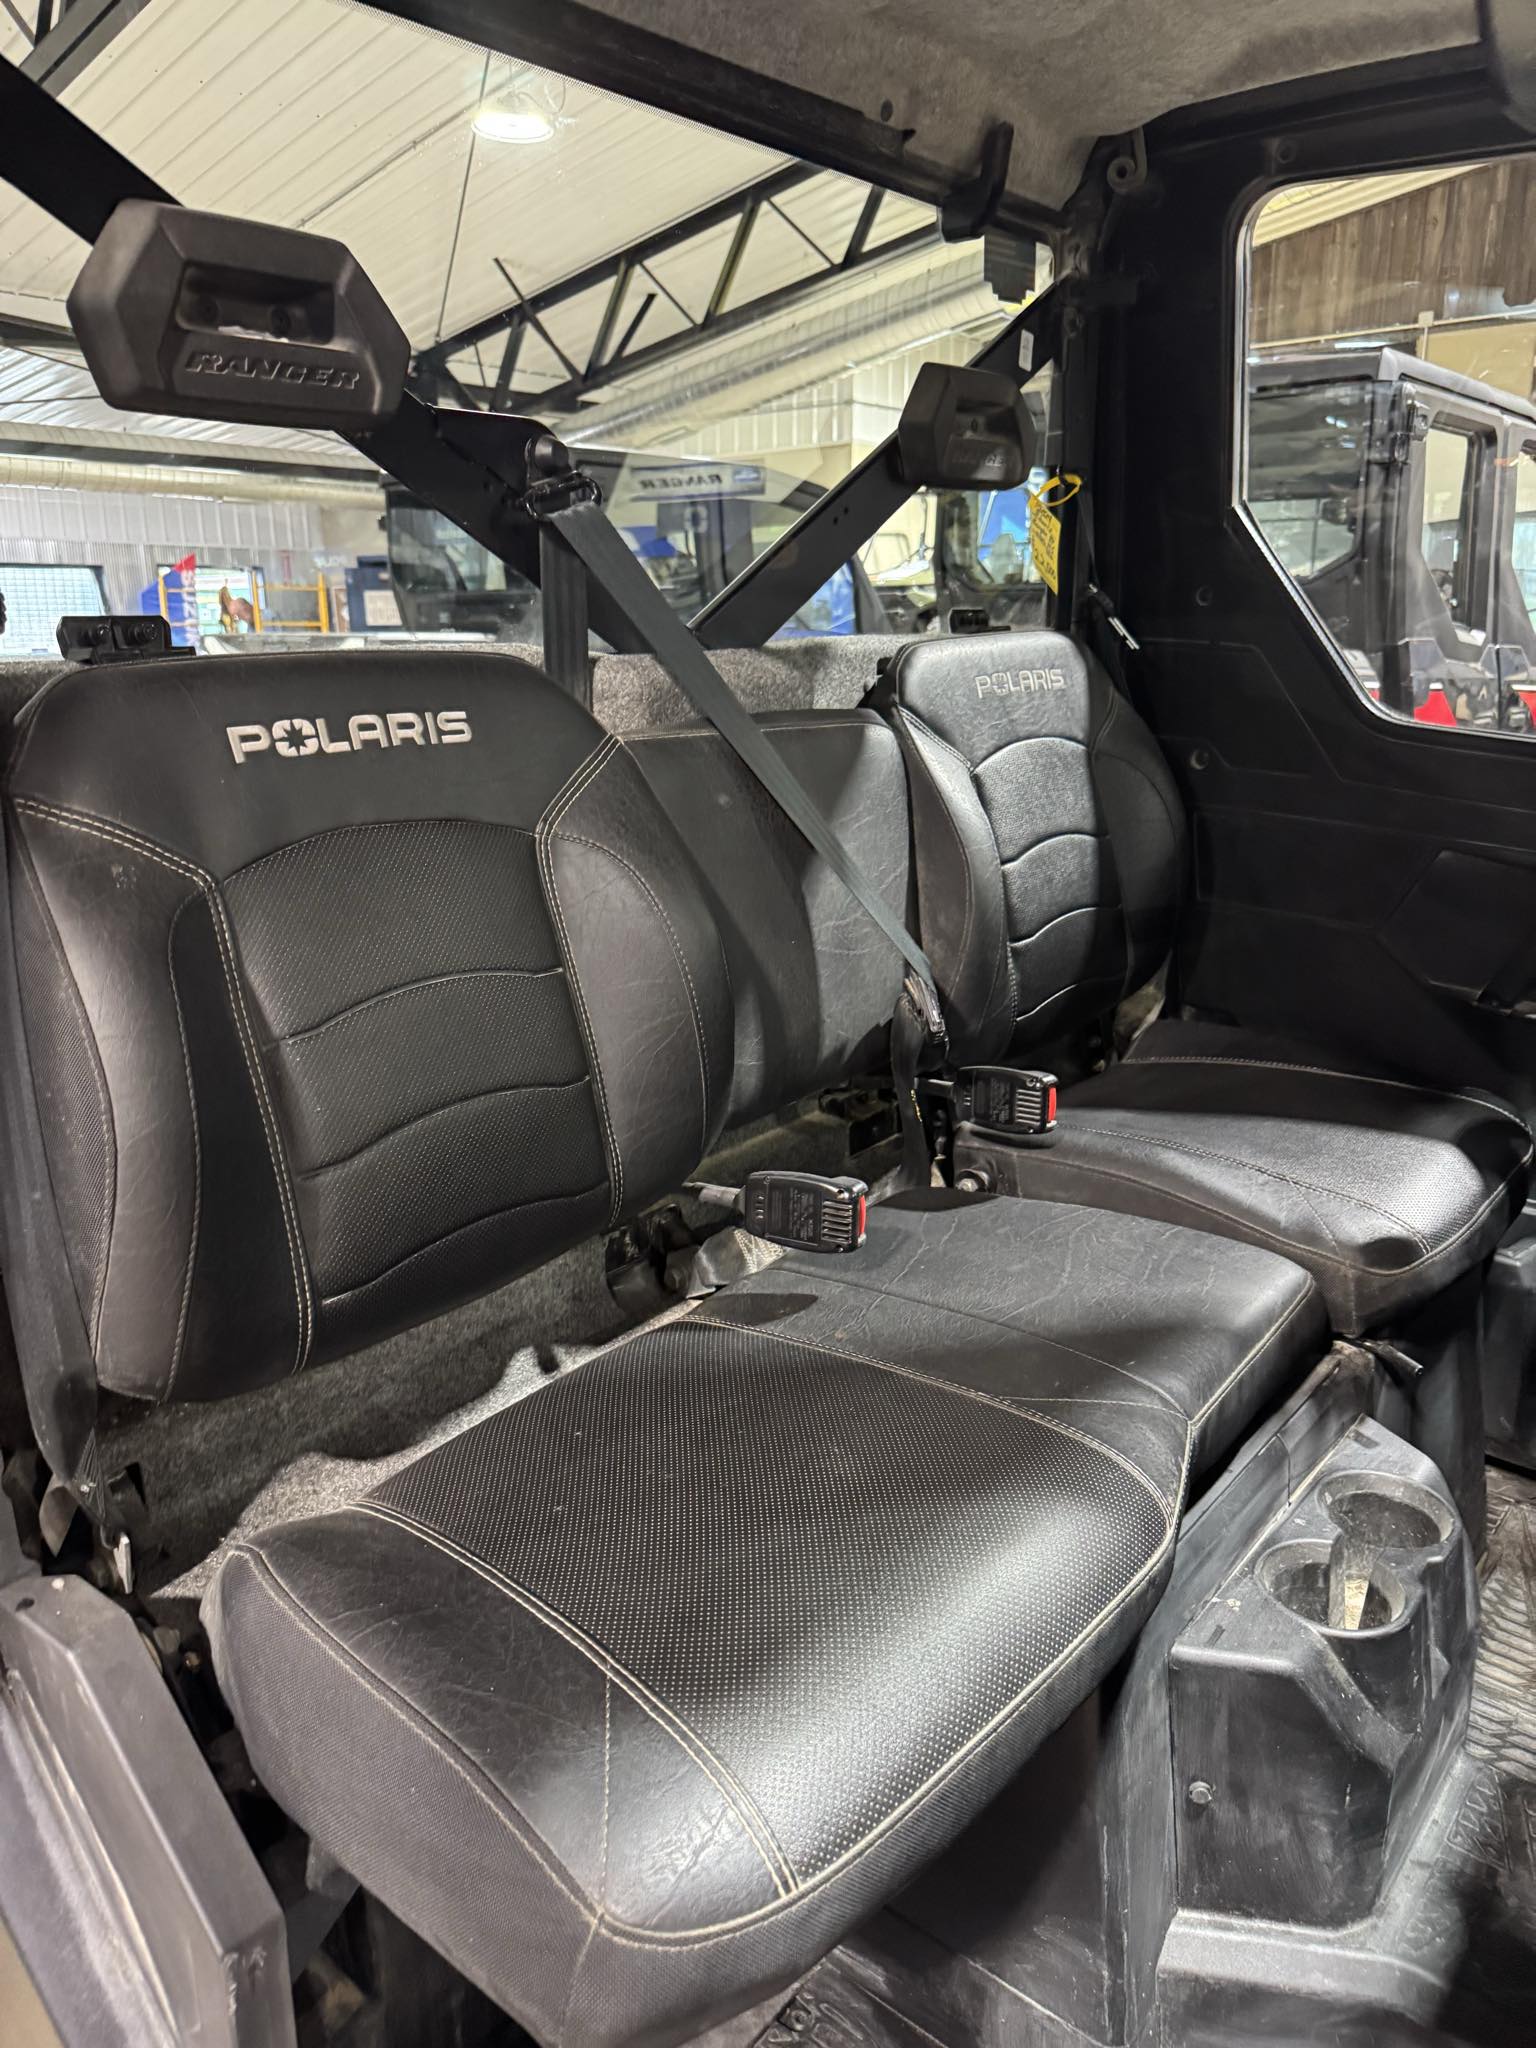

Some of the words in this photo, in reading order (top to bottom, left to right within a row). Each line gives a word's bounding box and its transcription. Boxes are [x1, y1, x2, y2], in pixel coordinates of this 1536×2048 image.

[185, 352, 361, 390] RANGER
[975, 668, 1065, 699] POLARIS
[226, 710, 473, 765] POLARIS
